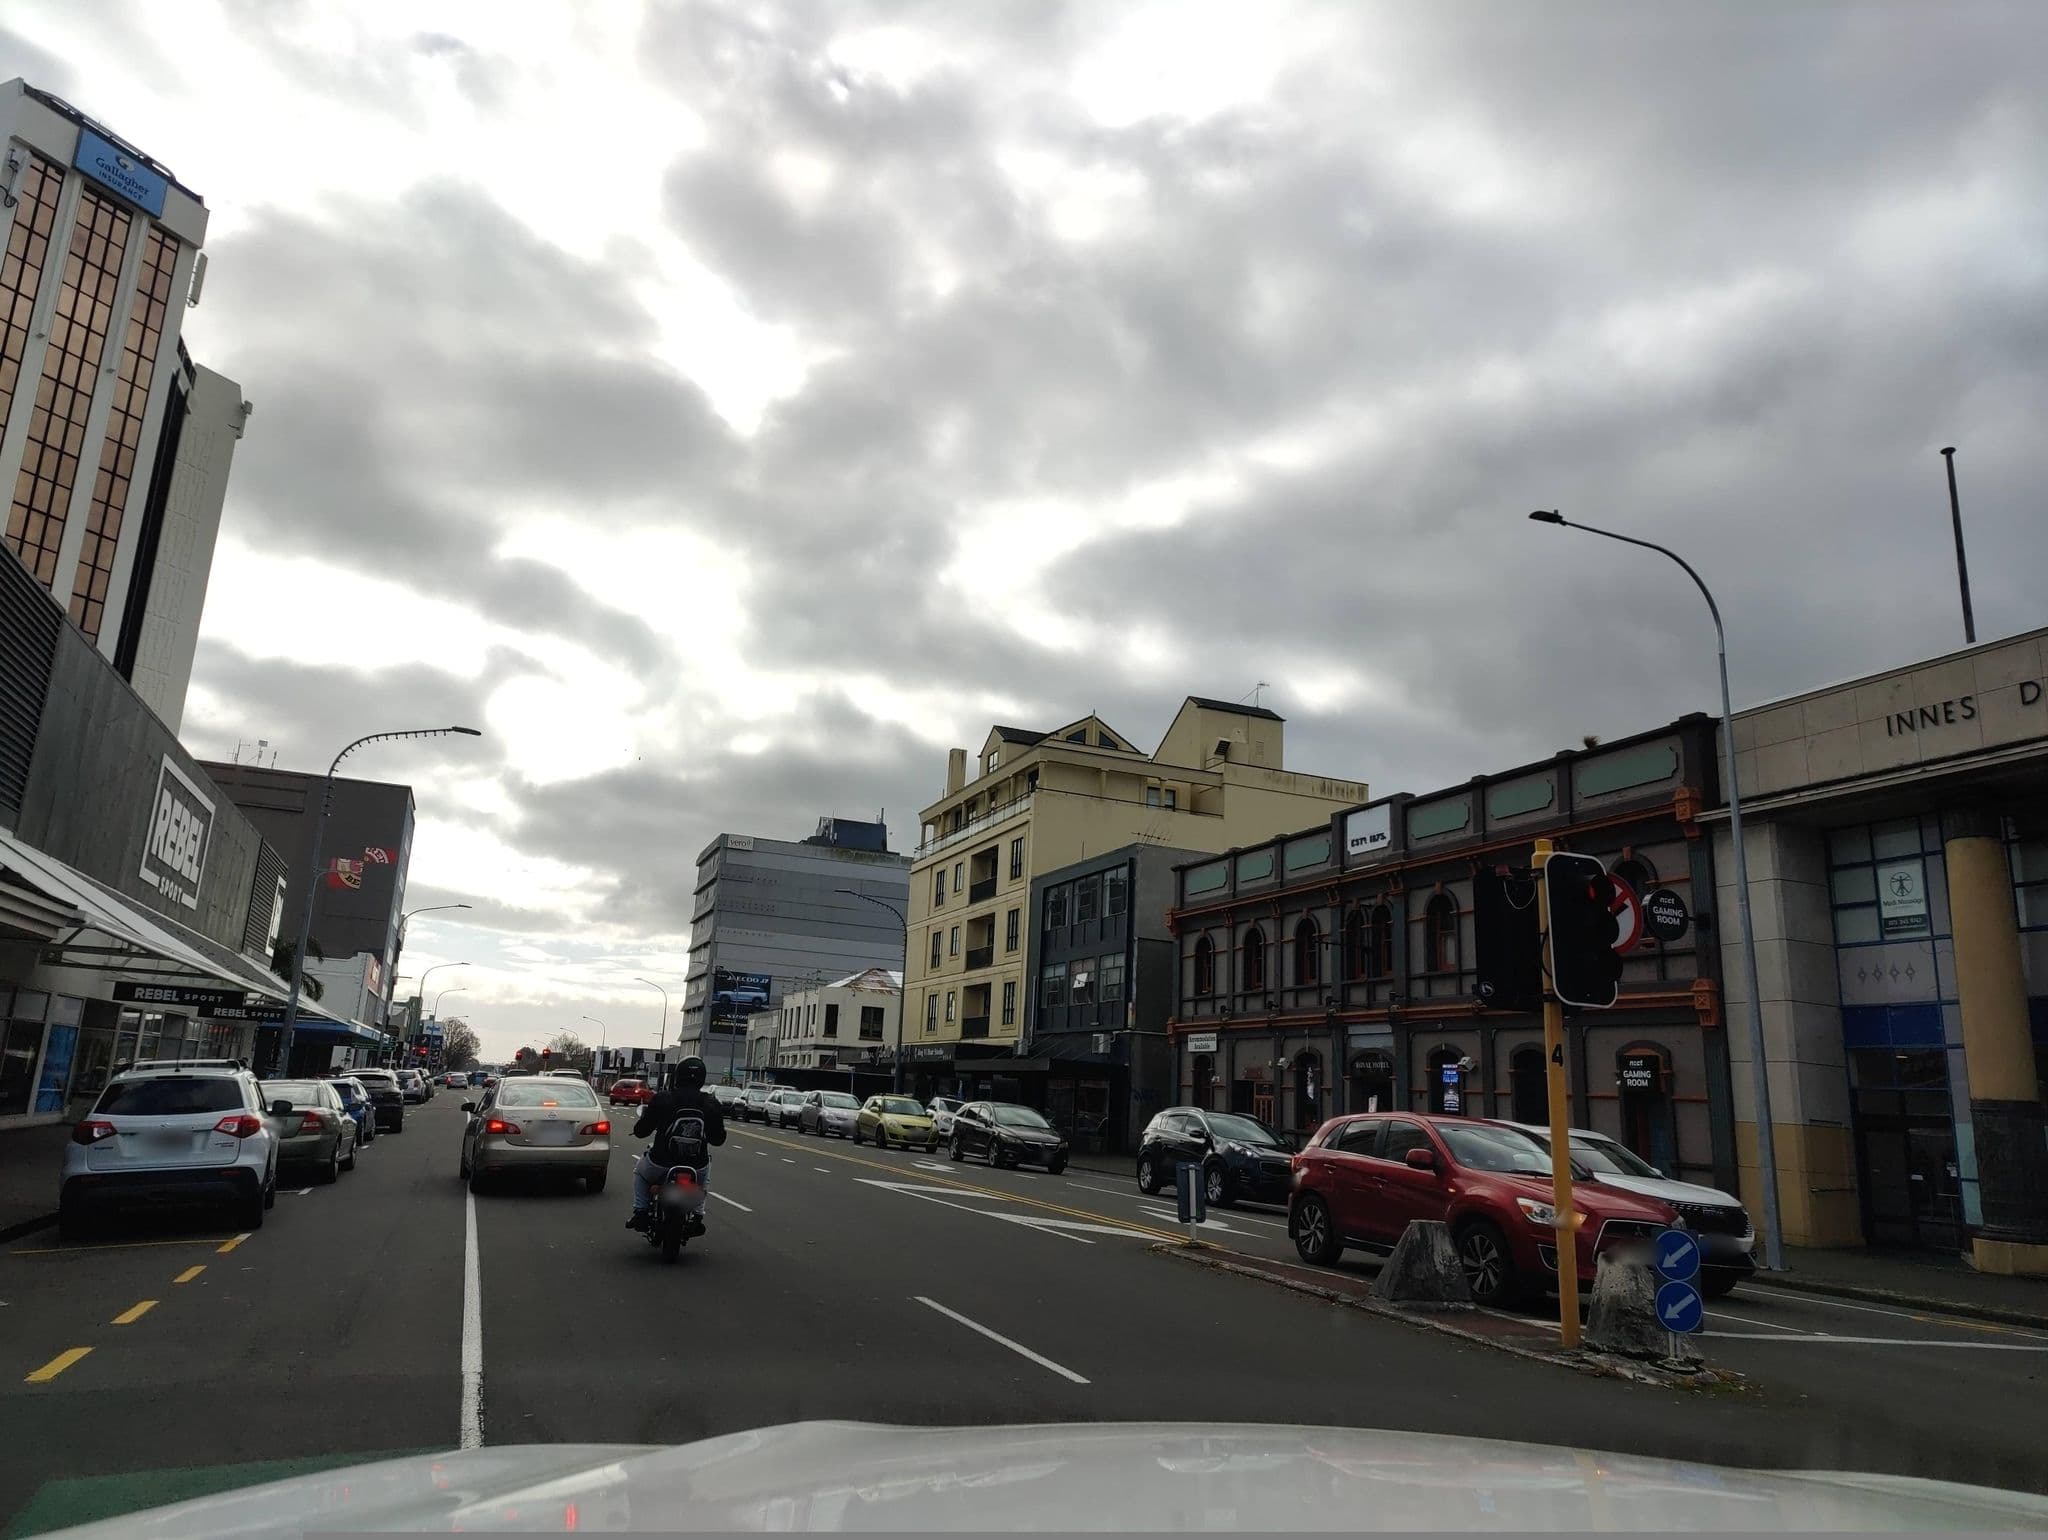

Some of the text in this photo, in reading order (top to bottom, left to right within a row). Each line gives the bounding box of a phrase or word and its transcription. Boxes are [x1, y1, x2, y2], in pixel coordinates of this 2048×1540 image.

[96, 157, 150, 195] Gallagher
[99, 170, 144, 201] INSURANCE
[1886, 696, 1976, 737] INNES
[151, 787, 205, 885] REBEL
[728, 839, 747, 847] vero
[159, 875, 183, 904] SPORT
[1652, 906, 1684, 918] GAMING
[1656, 915, 1681, 926] ROOM
[134, 987, 224, 1003] REBEL SPORT
[213, 1007, 248, 1018] REBEL
[1552, 1043, 1563, 1067] 4
[1623, 1070, 1652, 1079] GAMING
[1626, 1078, 1649, 1087] ROOM
